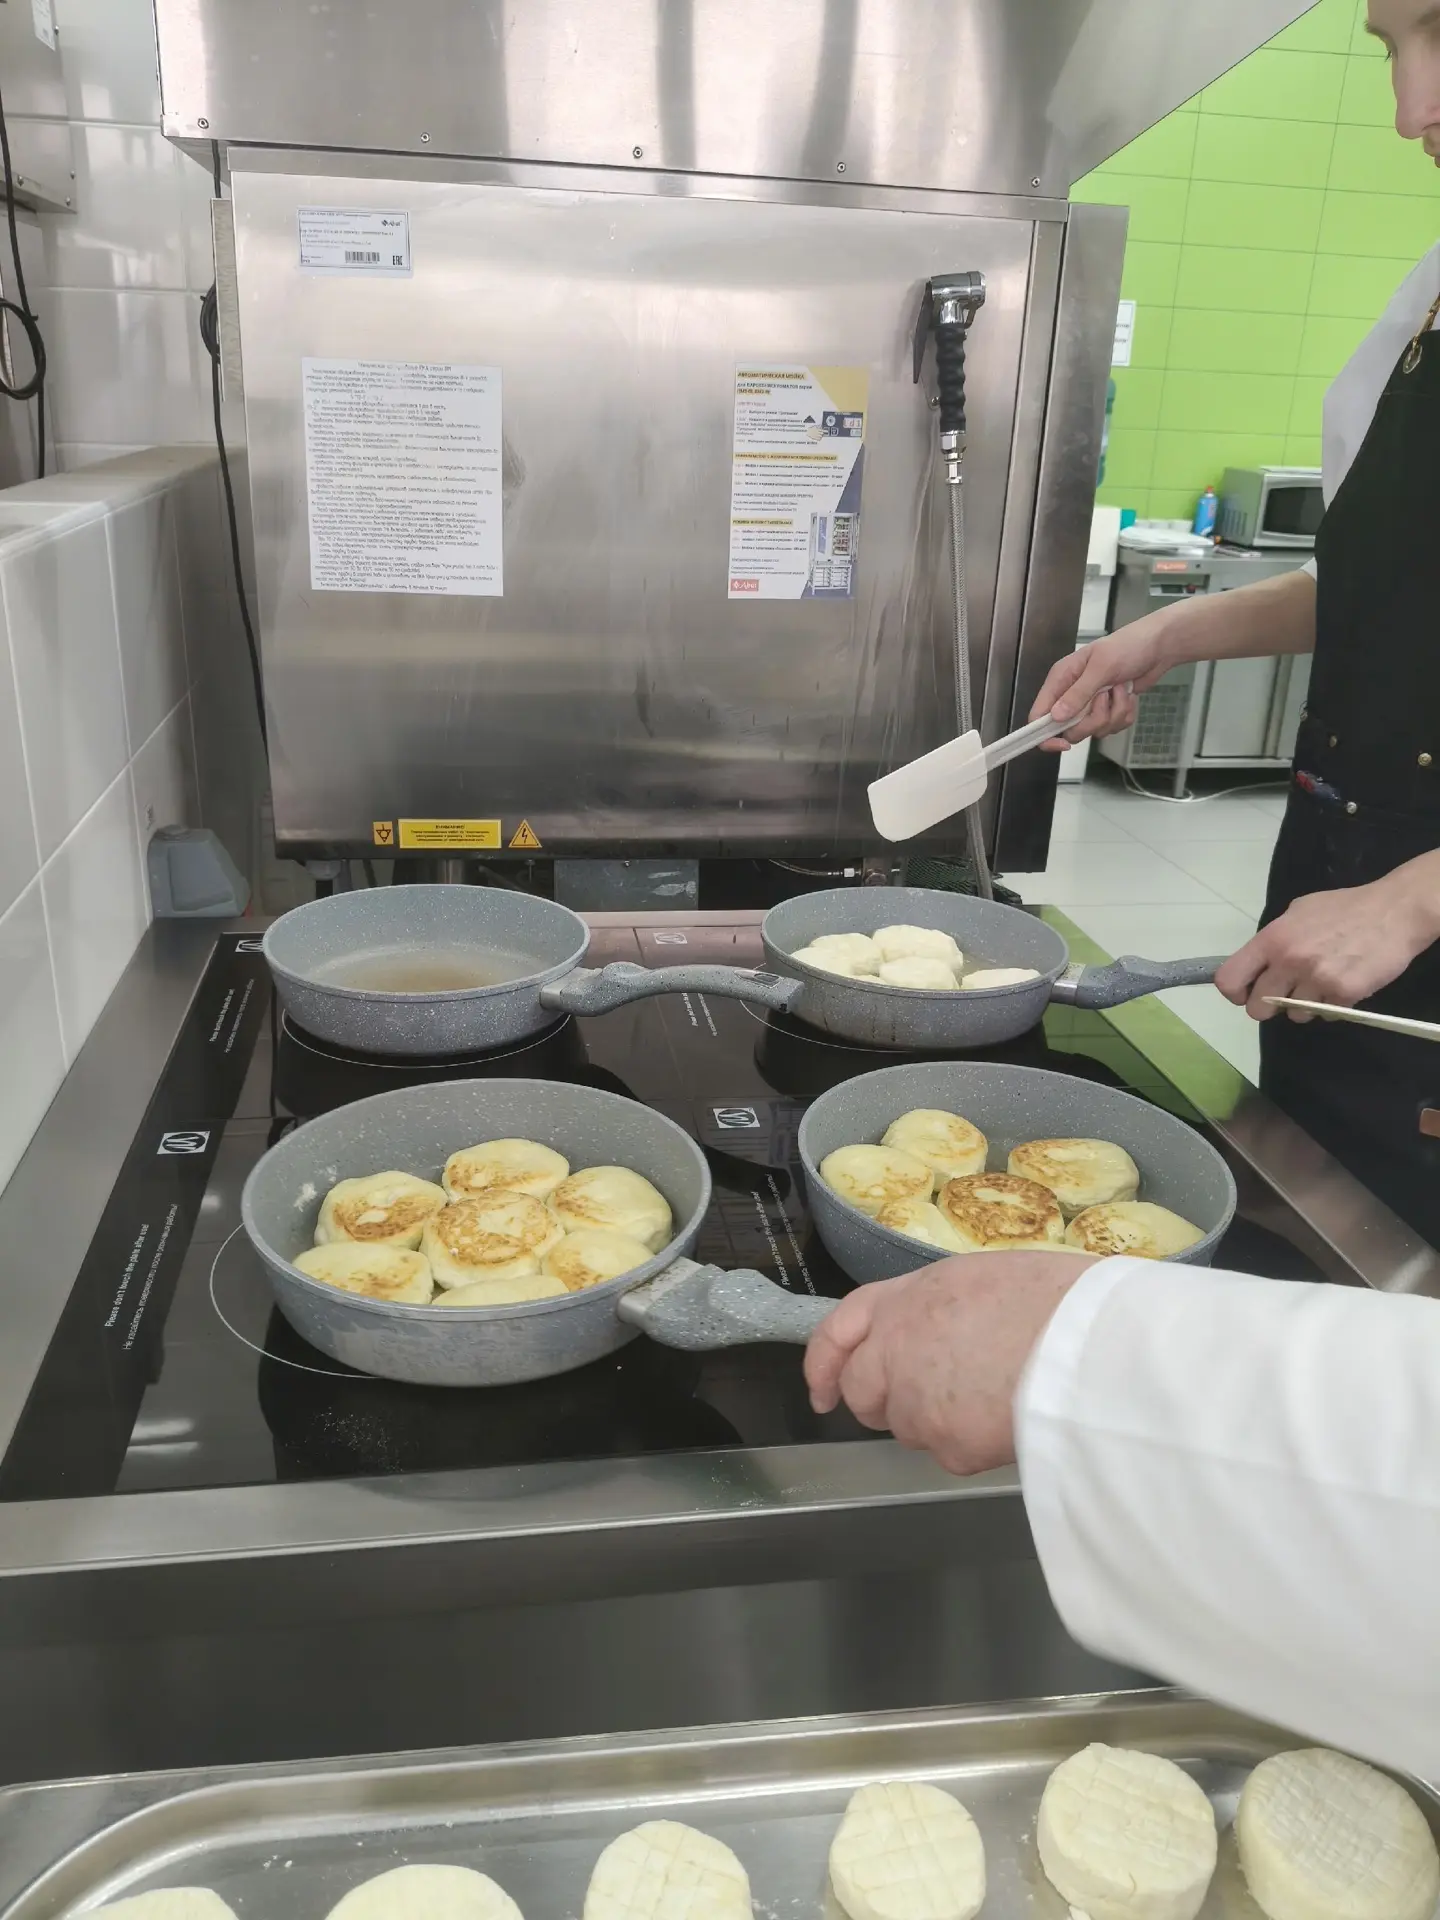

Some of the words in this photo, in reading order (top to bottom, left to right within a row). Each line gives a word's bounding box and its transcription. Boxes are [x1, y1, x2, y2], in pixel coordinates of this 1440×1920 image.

[104, 1306, 120, 1327] Please
[113, 1290, 126, 1306] don't
[125, 1262, 135, 1273] the
[123, 1340, 133, 1350] Не
